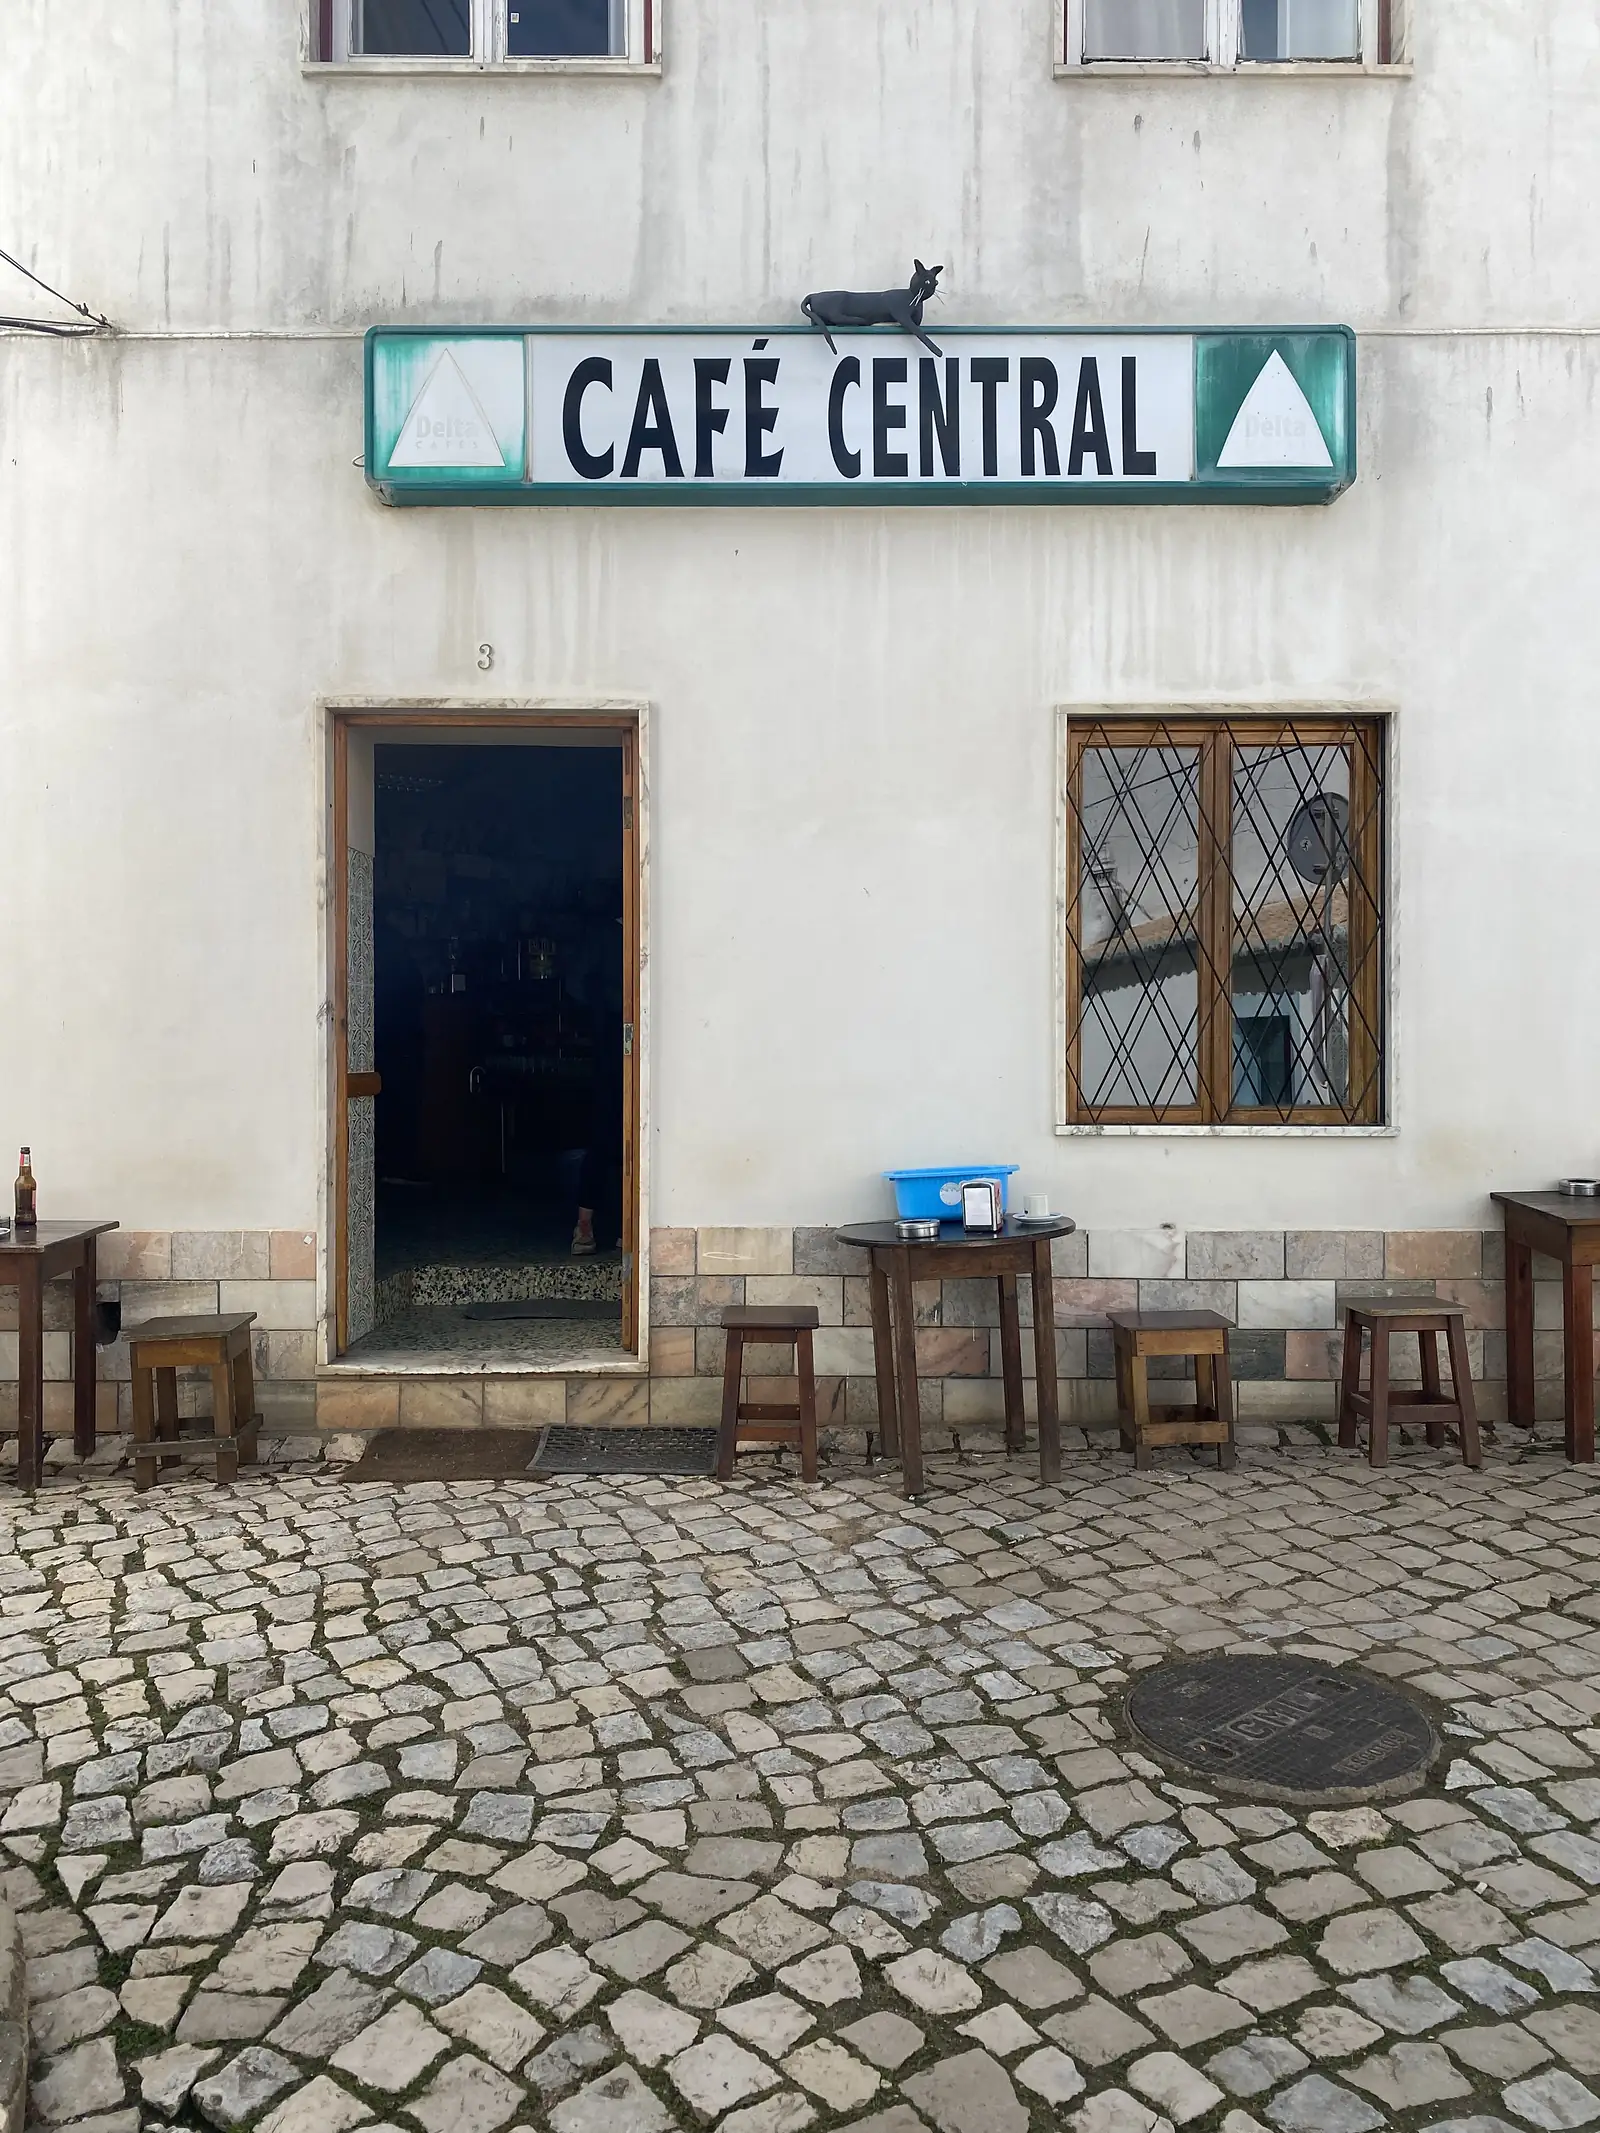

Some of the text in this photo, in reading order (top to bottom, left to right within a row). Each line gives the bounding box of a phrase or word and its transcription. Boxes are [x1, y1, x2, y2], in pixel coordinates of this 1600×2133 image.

[562, 338, 1157, 479] CAFÉ CENTRAL
[416, 414, 479, 438] Delta
[1245, 414, 1306, 438] Delta
[477, 643, 493, 670] 3
